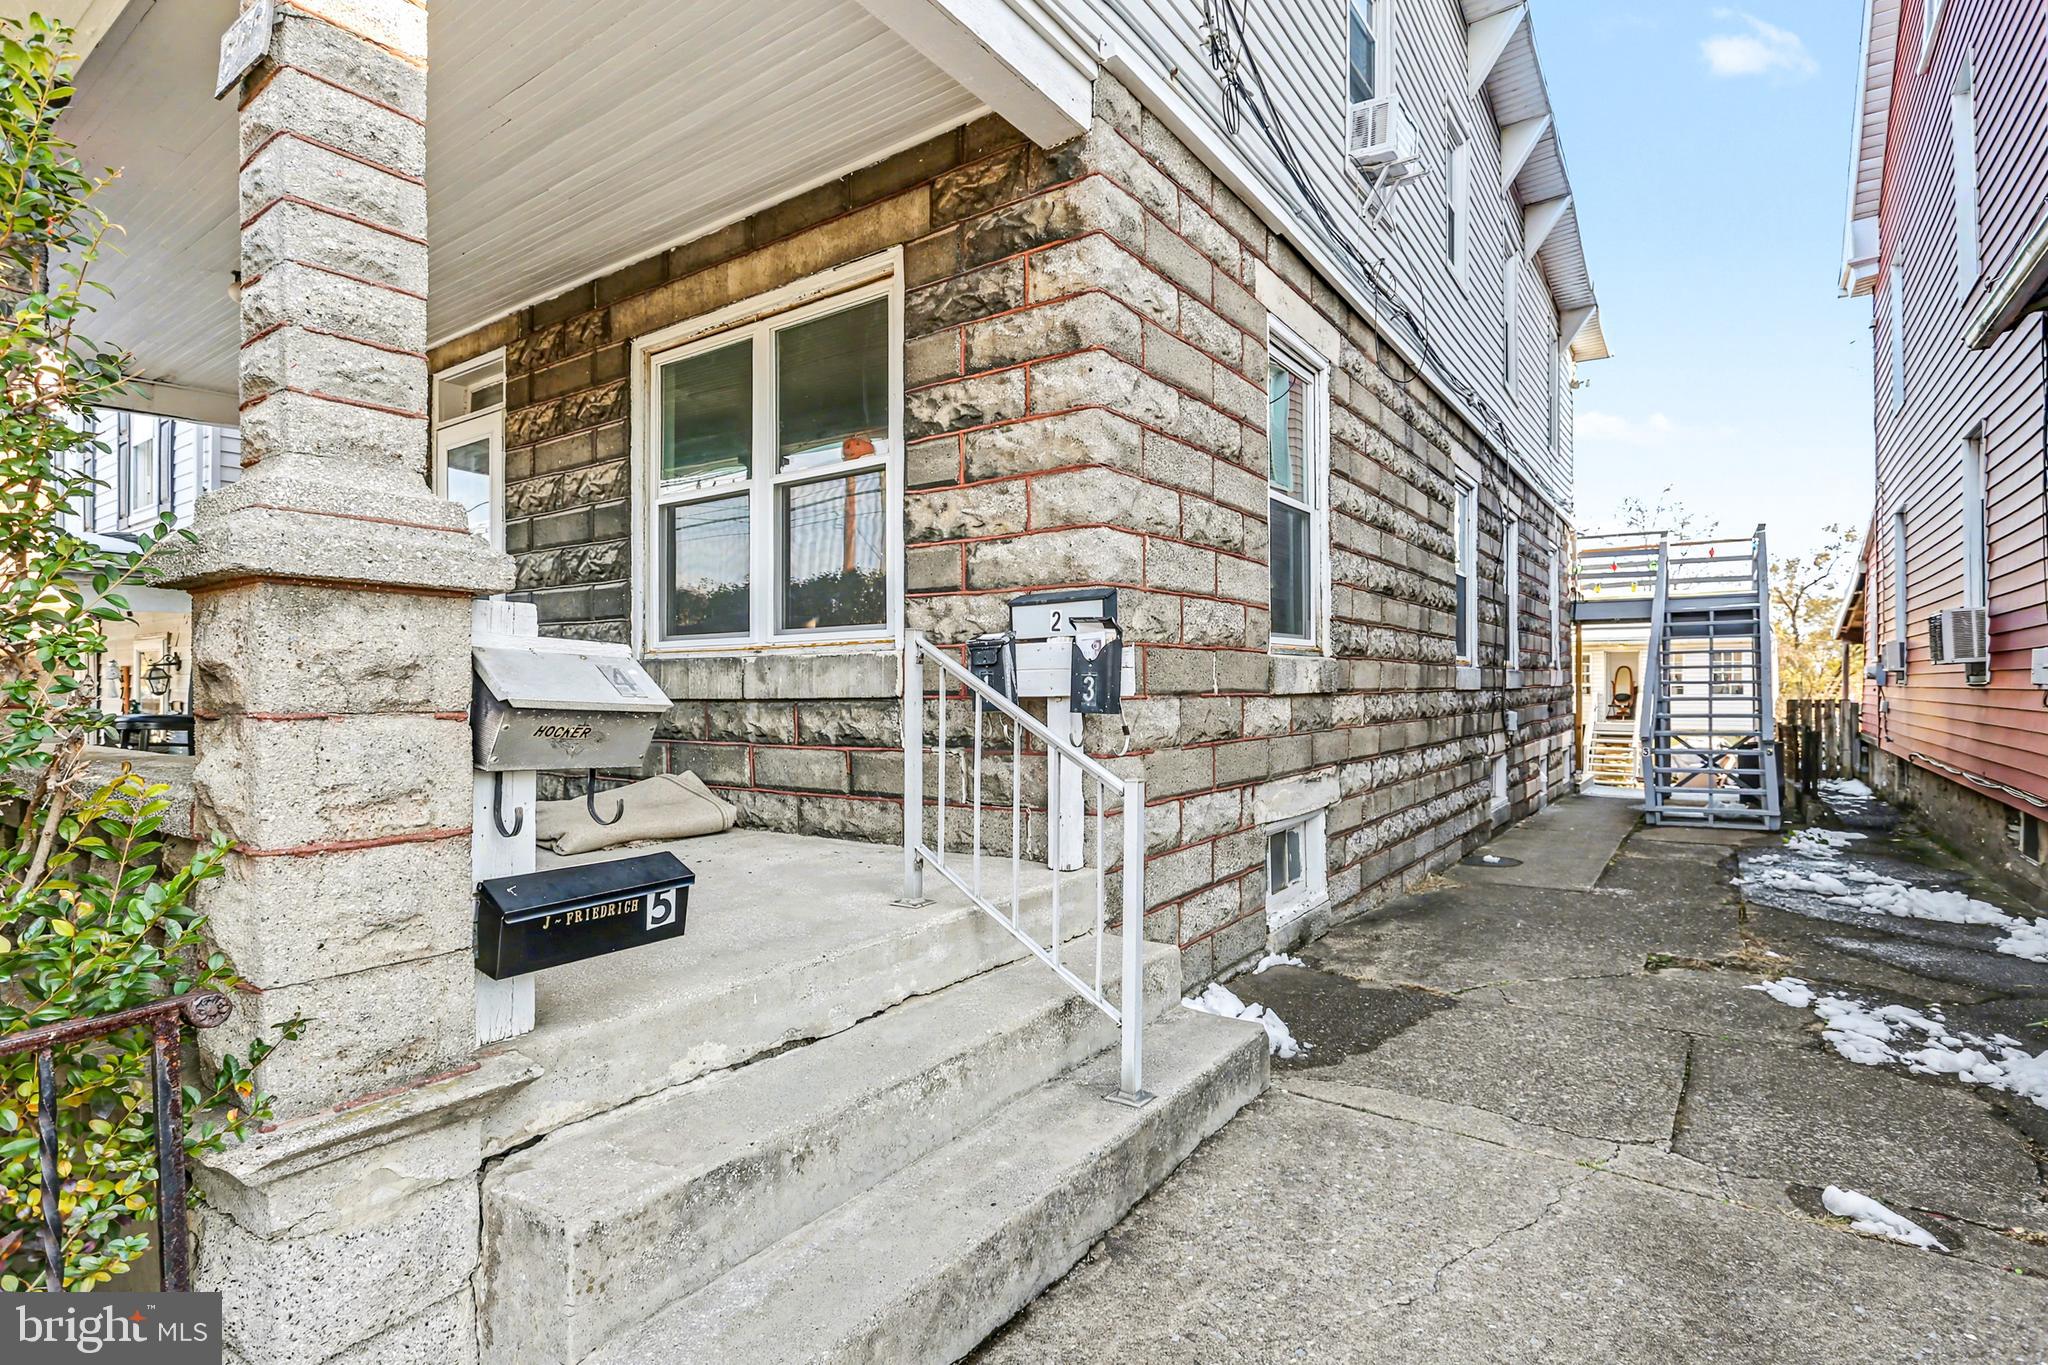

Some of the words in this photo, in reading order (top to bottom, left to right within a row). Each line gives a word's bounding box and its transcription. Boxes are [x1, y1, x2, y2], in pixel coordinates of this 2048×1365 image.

[1051, 611, 1061, 631] 2
[613, 667, 638, 692] 4
[1082, 676, 1095, 701] 3
[533, 725, 592, 739] HOCKER
[566, 899, 640, 925] FRIEDRICH
[651, 889, 673, 925] 5
